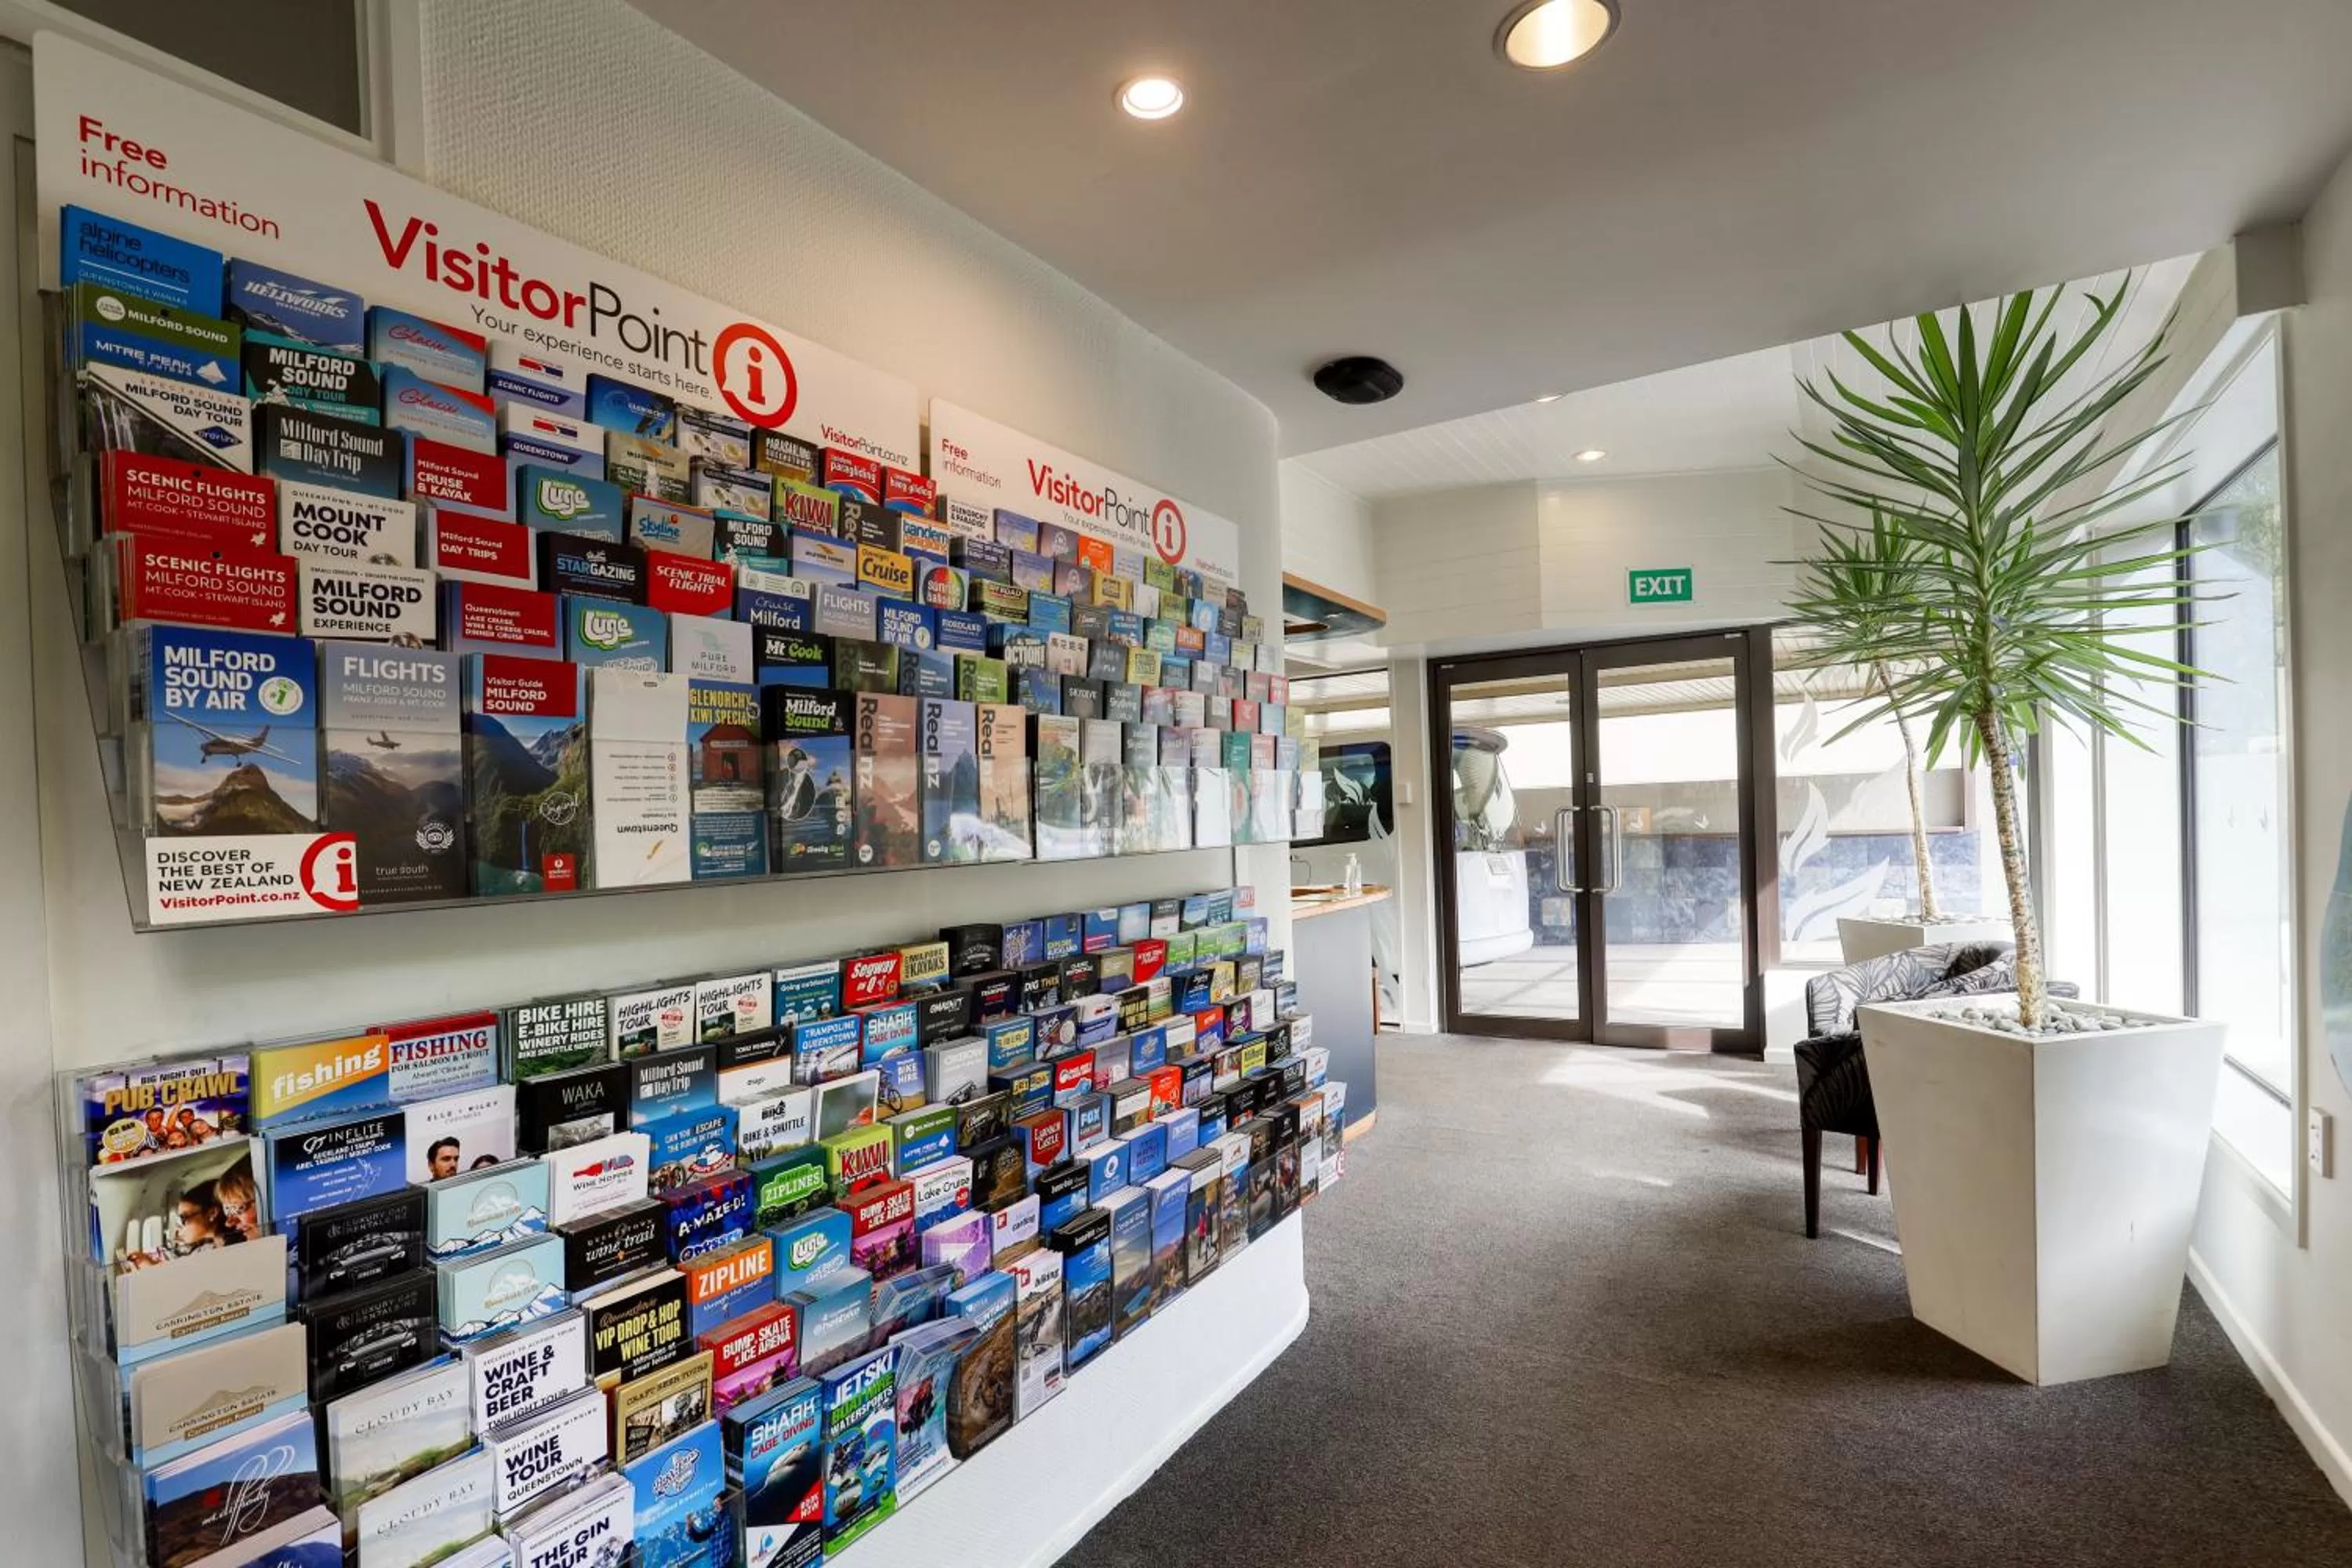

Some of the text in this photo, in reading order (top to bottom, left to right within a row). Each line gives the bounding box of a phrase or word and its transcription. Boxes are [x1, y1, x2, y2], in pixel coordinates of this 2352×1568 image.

[80, 114, 167, 169] Free
[82, 149, 280, 239] information
[80, 220, 142, 252] alpine
[79, 237, 190, 283] helicopters
[364, 198, 707, 376] VisitorPoint
[128, 310, 228, 344] MILFORD SOUND
[96, 340, 145, 362] MITRE
[269, 347, 355, 376] MILFORD
[470, 303, 713, 400] Your experience starts here.
[284, 368, 347, 391] SOUND
[125, 382, 243, 418] MILFORD SOUND
[173, 405, 244, 428] DAY TOUR
[280, 417, 384, 457] Milford Sound
[941, 437, 970, 460] Free
[417, 459, 480, 481] Milford Sound
[417, 470, 464, 489] CRUISE
[942, 458, 1002, 491] information
[126, 468, 267, 505] SCENIC FLIGHTS
[430, 485, 473, 503] KAYAK
[1028, 459, 1152, 536] VisitorPoint
[126, 485, 266, 519] MILFORD SOUND
[146, 502, 267, 530] COOK ISLAND
[292, 500, 387, 532] MOUNT
[727, 519, 773, 536] MILFORD
[292, 521, 368, 548] COOK
[441, 531, 503, 550] Milford Sound
[734, 534, 768, 548] SOUND
[294, 540, 358, 560] DAY TOUR
[441, 543, 497, 561] DAY TRIPS
[145, 554, 286, 584] SCENIC FLIGHTS
[556, 553, 637, 583] STARGAZING
[656, 565, 695, 580] SCENIC
[862, 554, 909, 585] Cruise
[145, 568, 285, 602] MILFORD SOUND
[311, 578, 423, 608] MILFORD
[670, 578, 716, 595] FLIGHTS
[1635, 575, 1686, 597] EXIT
[165, 586, 286, 613] COOK ISLAND
[313, 597, 401, 624] SOUND
[754, 596, 796, 612] Cruise
[823, 596, 871, 615] FLIGHTS
[314, 617, 394, 633] EXPERIENCE
[750, 608, 801, 630] Milford
[884, 607, 922, 626] MILFORD
[165, 644, 277, 673] MILFORD
[700, 652, 728, 663] PURE
[765, 639, 824, 662] Mt Cook
[165, 666, 253, 692] SOUND
[343, 656, 447, 685] FLIGHTS
[691, 662, 738, 675] MILFORD
[343, 682, 447, 702] MILFORD SOUND
[487, 676, 543, 689] Visitor Guide
[487, 687, 548, 702] MILFORD
[165, 688, 247, 711] BY AIR
[487, 700, 535, 713] SOUND
[689, 688, 753, 709] GLENORCHY
[785, 699, 837, 718] Milford
[689, 707, 714, 724] KIWI
[785, 713, 829, 730] Sound
[618, 822, 679, 834] Queenstown
[157, 849, 251, 864] DISCOVER
[157, 862, 274, 877] THE BEST OF
[158, 873, 295, 891] NEW ZEALAND
[376, 865, 397, 877] true
[160, 891, 300, 909] VisitorPoint.co.nz
[618, 989, 691, 1018] HIGHLIGHTS
[699, 978, 764, 1004] HIGHLIGHTS
[518, 999, 606, 1025] BIKE HIRE
[699, 1000, 729, 1018] TOUR
[518, 1014, 605, 1039] E-BIKE HIRE
[618, 1014, 652, 1033] TOUR
[805, 1021, 855, 1039] TRAMPOLINE
[391, 1029, 488, 1065] FISHING
[518, 1028, 606, 1051] WINERY RIDES
[802, 1029, 858, 1050] QUEENSTOWN
[412, 1048, 489, 1070] SALMON TROUT
[272, 1042, 383, 1105] fishing
[104, 1071, 242, 1115] PUB CRAWL
[561, 1081, 605, 1106] WAKA
[328, 1122, 385, 1143] INFLITE
[742, 1115, 806, 1144] BIKE SHUTTLE
[841, 1139, 888, 1179] KIWI
[764, 1171, 821, 1203] ZIPLINES
[678, 1194, 746, 1238] A-MAZE-D!
[624, 1223, 656, 1250] trail
[698, 1250, 767, 1299] ZIPLINE
[595, 1298, 681, 1351] VIP DROP HOP
[620, 1319, 681, 1363] WINE TOUR
[484, 1344, 556, 1385] WINE &
[485, 1361, 550, 1400] CRAFT
[485, 1386, 535, 1418] BEER
[488, 1387, 569, 1431] TWILIGHT TOUR
[751, 1395, 816, 1446] SHARK
[750, 1417, 815, 1460] CAGE DIVING
[505, 1435, 560, 1471] WINE
[505, 1450, 564, 1488] TOUR
[507, 1456, 584, 1502] QUEENSTOWN
[532, 1539, 570, 1568] THE
[573, 1516, 611, 1546] GIN
